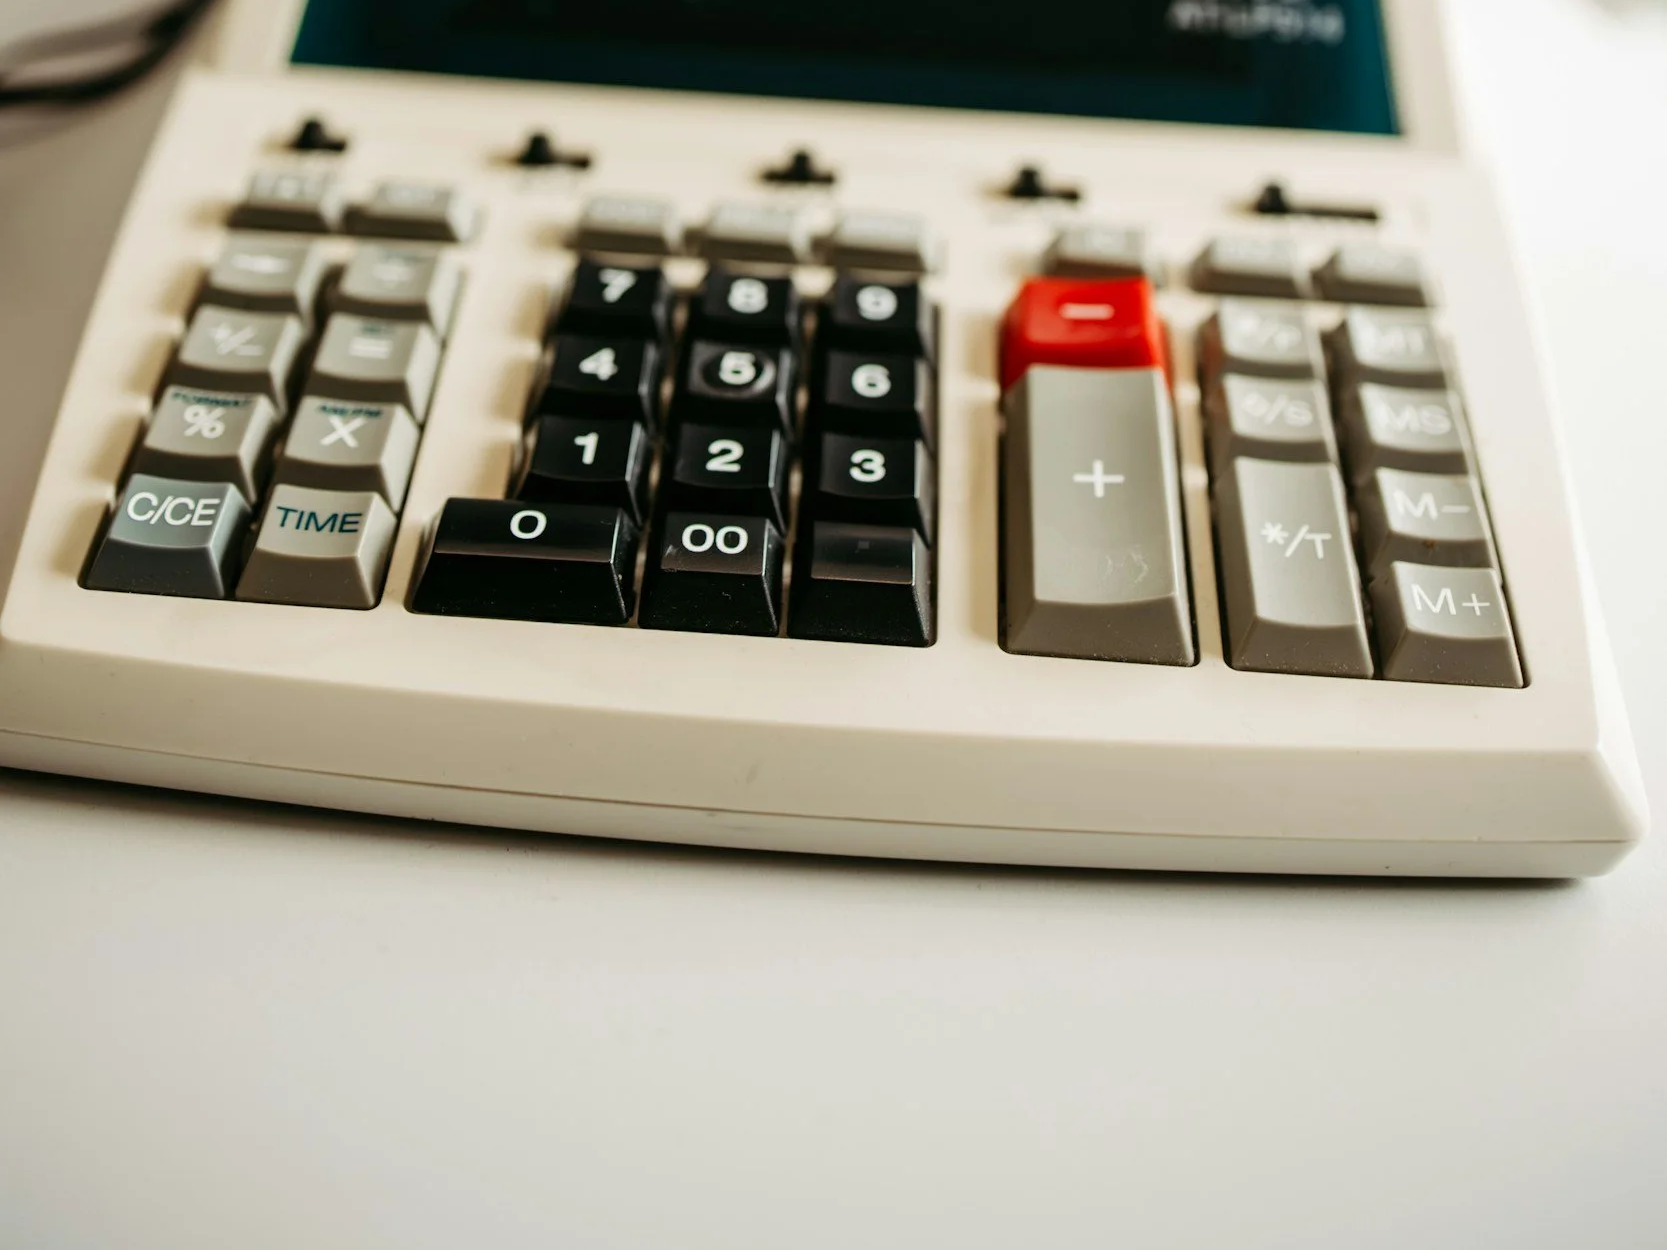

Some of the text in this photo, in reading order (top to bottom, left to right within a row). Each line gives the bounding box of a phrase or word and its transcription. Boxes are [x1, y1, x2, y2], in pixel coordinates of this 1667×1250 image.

[599, 268, 637, 303] 7
[727, 277, 769, 314] 8
[855, 284, 898, 321] 9
[579, 347, 618, 381] 4
[718, 352, 756, 385] 5
[851, 363, 892, 398] 6
[184, 405, 226, 440] %
[1374, 402, 1452, 435] MS
[573, 431, 599, 465] 1
[706, 439, 744, 473] 2
[849, 449, 887, 483] 3
[126, 490, 222, 528] C/CE
[275, 505, 363, 535] TIME
[509, 509, 548, 540] 0
[681, 522, 749, 555] 00
[1410, 582, 1491, 618] M+
